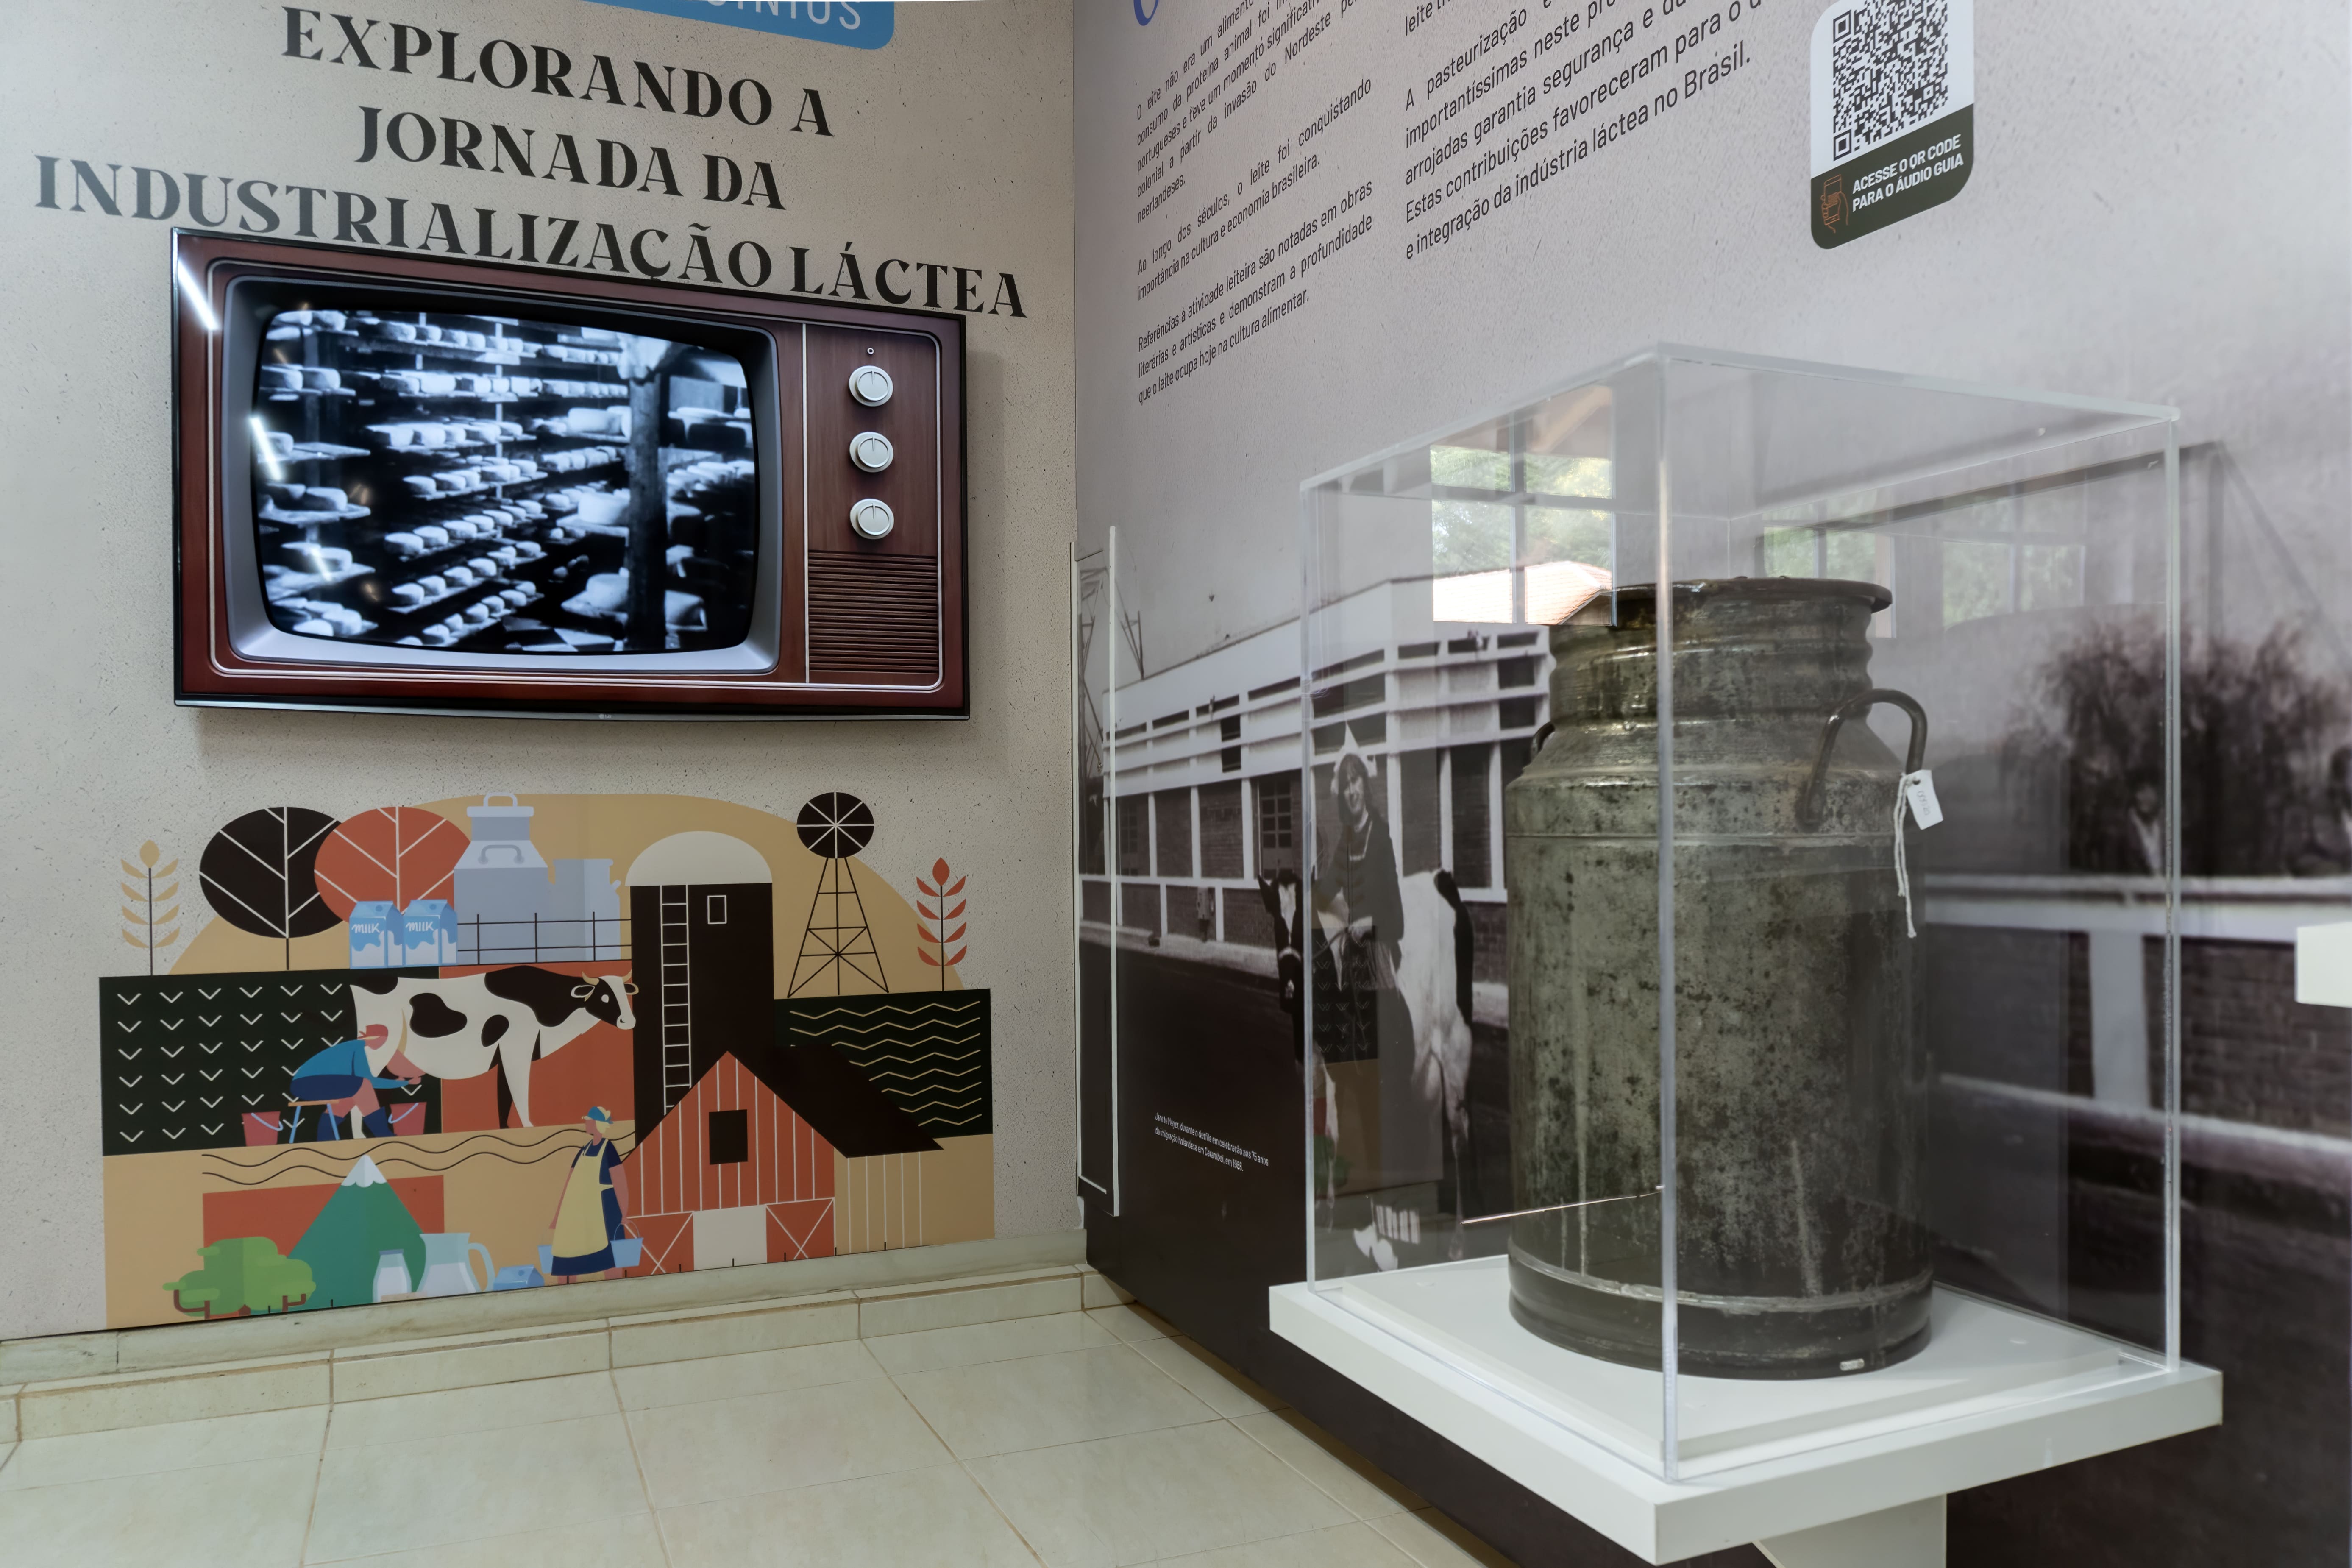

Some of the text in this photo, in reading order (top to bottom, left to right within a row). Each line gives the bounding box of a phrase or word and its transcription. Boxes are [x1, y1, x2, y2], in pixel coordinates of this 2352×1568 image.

[281, 6, 835, 137] EXPLORANDO A
[1137, 1, 1269, 146] consumo da proteína animal foi
[1137, 104, 1142, 120] O
[1146, 88, 1161, 112] leite
[1166, 70, 1178, 92] não
[1183, 53, 1195, 73] era
[1200, 35, 1212, 56] um
[1406, 2, 1433, 36] leite
[1406, 88, 1414, 111] A
[1427, 8, 1527, 101] pasteurização
[1406, 13, 1580, 149] importantíssimas neste
[353, 106, 786, 210] JORNADA DA
[1137, 11, 1331, 197] colonial a partir da invasão do Nordeste
[1137, 123, 1180, 176] portugueses
[1183, 117, 1187, 129] e
[1189, 98, 1205, 123] teve
[1208, 84, 1221, 105] um
[1223, 43, 1264, 91] momento
[1406, 132, 1468, 185] arrojadas
[1474, 85, 1536, 146] garantia
[1543, 21, 1634, 95] segurança
[1642, 8, 1653, 28] e
[1406, 188, 1442, 223] Estas
[1446, 121, 1548, 197] contribuições
[1553, 45, 1667, 131] favoreceram
[1676, 13, 1720, 64] para
[1729, 0, 1741, 22] o
[1406, 39, 1750, 260] e integração da indústria láctea no Brasil.
[1852, 134, 1961, 194] ACESSE O QR CODE
[35, 155, 1027, 318] INDUSTRIALIZAÇÃO LÁCTEA
[1138, 78, 1371, 275] Ao longo dos séculos, o leite foi conquistando
[1138, 175, 1185, 223] neerlandeses.
[1138, 154, 1320, 301] importância na cultura e economia brasileira.
[1853, 153, 1964, 212] PARA O ÁUDIO GUIA
[1138, 181, 1372, 352] Referências à atividade leiteira são notadas em obras
[1139, 214, 1372, 378] literárias e artísticas e demonstram a profundidade
[1139, 289, 1309, 406] que o leite ocupa hoje na cultura alimentar.
